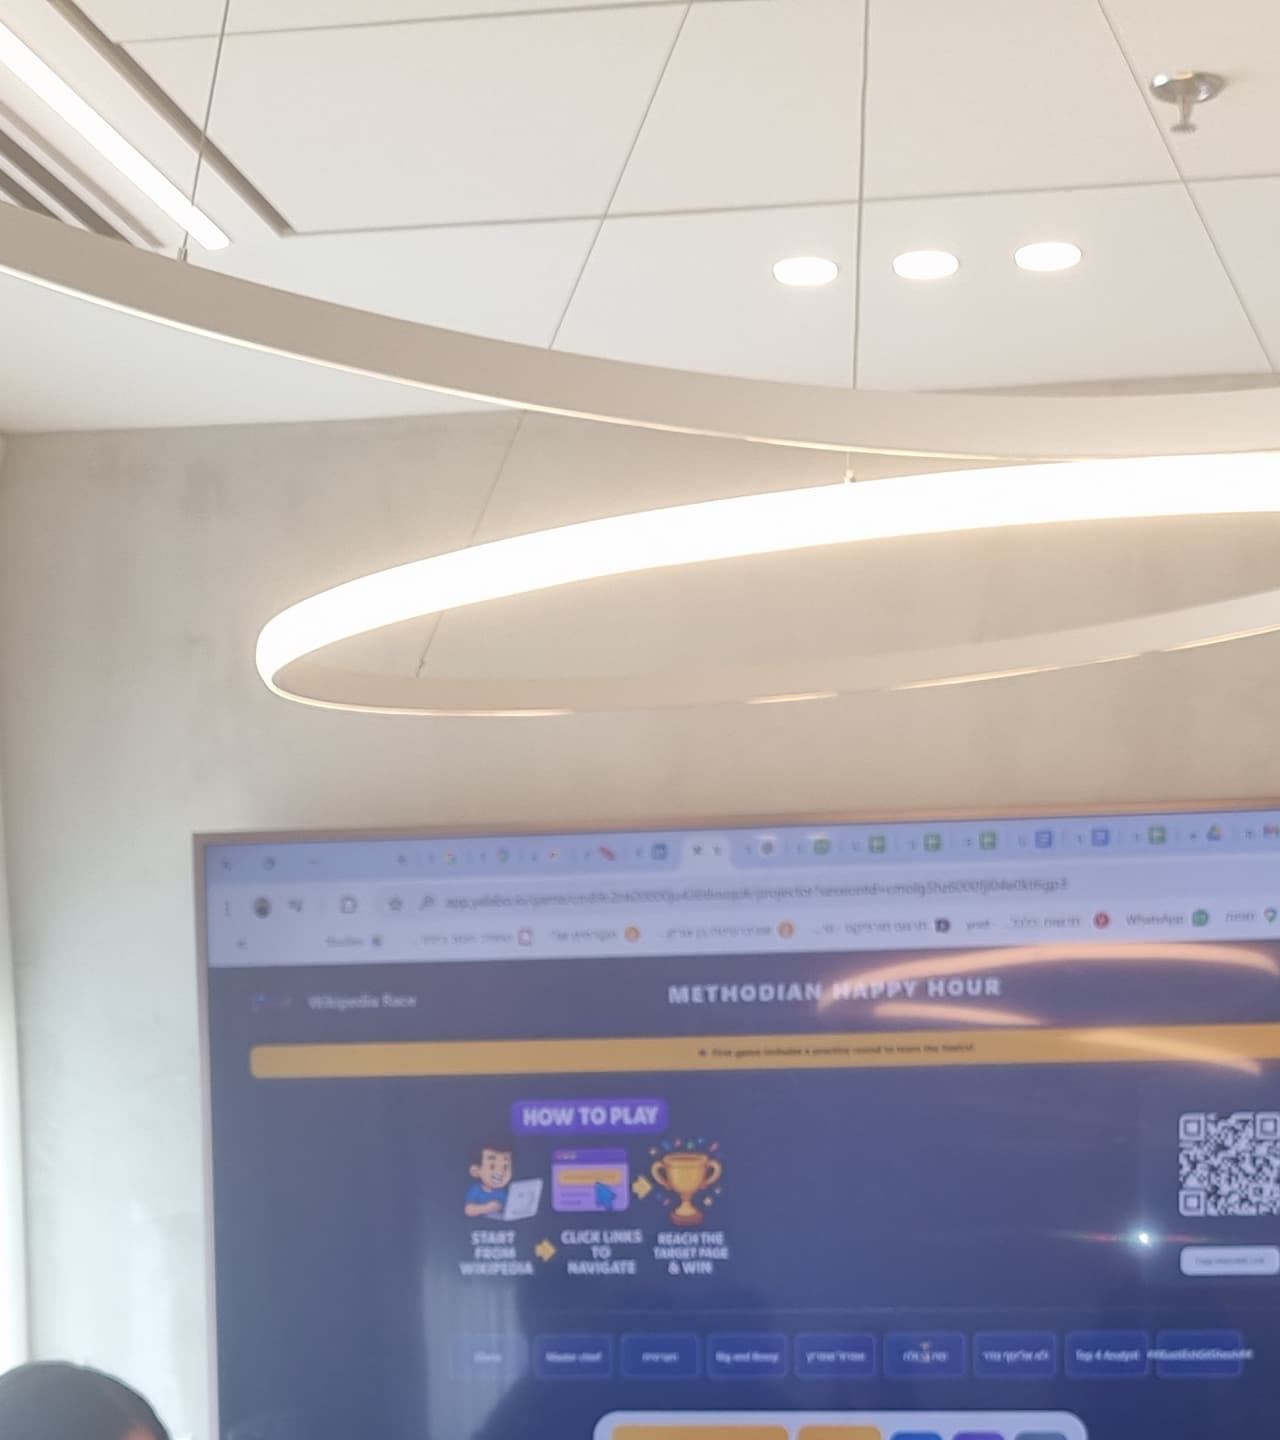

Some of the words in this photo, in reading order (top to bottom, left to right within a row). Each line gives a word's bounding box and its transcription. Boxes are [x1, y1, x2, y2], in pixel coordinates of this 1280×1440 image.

[668, 984, 821, 1004] METHODIAN
[833, 980, 916, 1001] HAPPY
[928, 977, 1001, 998] HOUR
[308, 994, 379, 1010] Wikipedia
[382, 994, 417, 1008] Race
[523, 1107, 575, 1127] HOW
[578, 1106, 606, 1126] TO
[610, 1105, 659, 1126] PLAY
[471, 1230, 516, 1245] START
[561, 1230, 600, 1244] CLICK
[603, 1229, 643, 1244] LINKS
[657, 1233, 699, 1247] REACH
[701, 1232, 724, 1246] THE
[474, 1246, 517, 1260] FROM
[591, 1245, 611, 1259] TO
[654, 1247, 696, 1261] TARGET
[699, 1246, 728, 1261] PAGE
[460, 1261, 534, 1276] WIKIPEDIA
[567, 1260, 637, 1275] NAVIGATE
[682, 1261, 713, 1275] WIN
